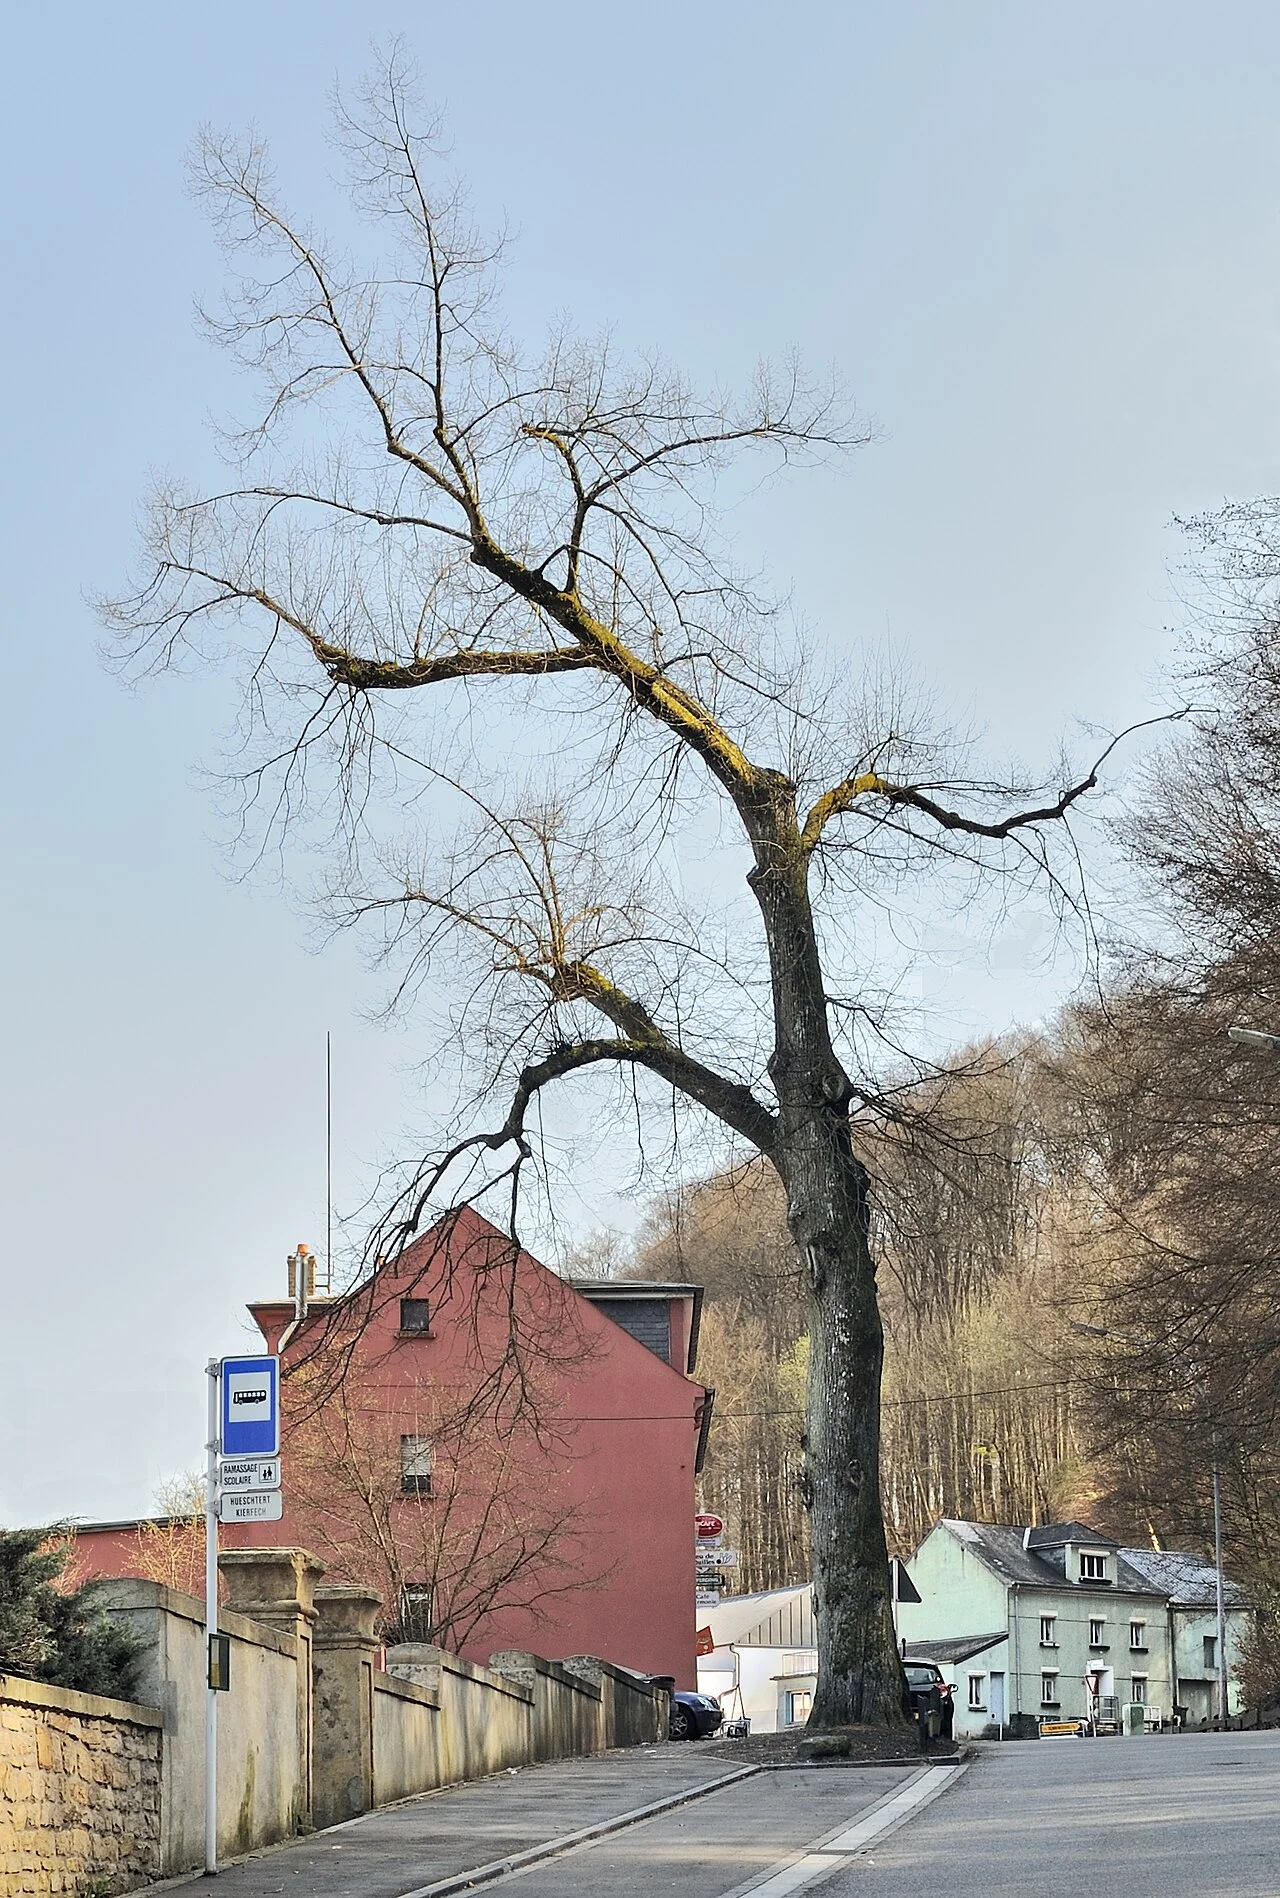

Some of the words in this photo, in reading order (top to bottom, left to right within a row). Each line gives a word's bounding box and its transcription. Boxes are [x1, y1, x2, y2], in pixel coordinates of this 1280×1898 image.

[224, 1464, 257, 1473] RAMASSAGE
[224, 1476, 251, 1485] SCOLAIRE
[231, 1496, 270, 1505] HUESCHTERT
[236, 1508, 266, 1517] KIERFECH
